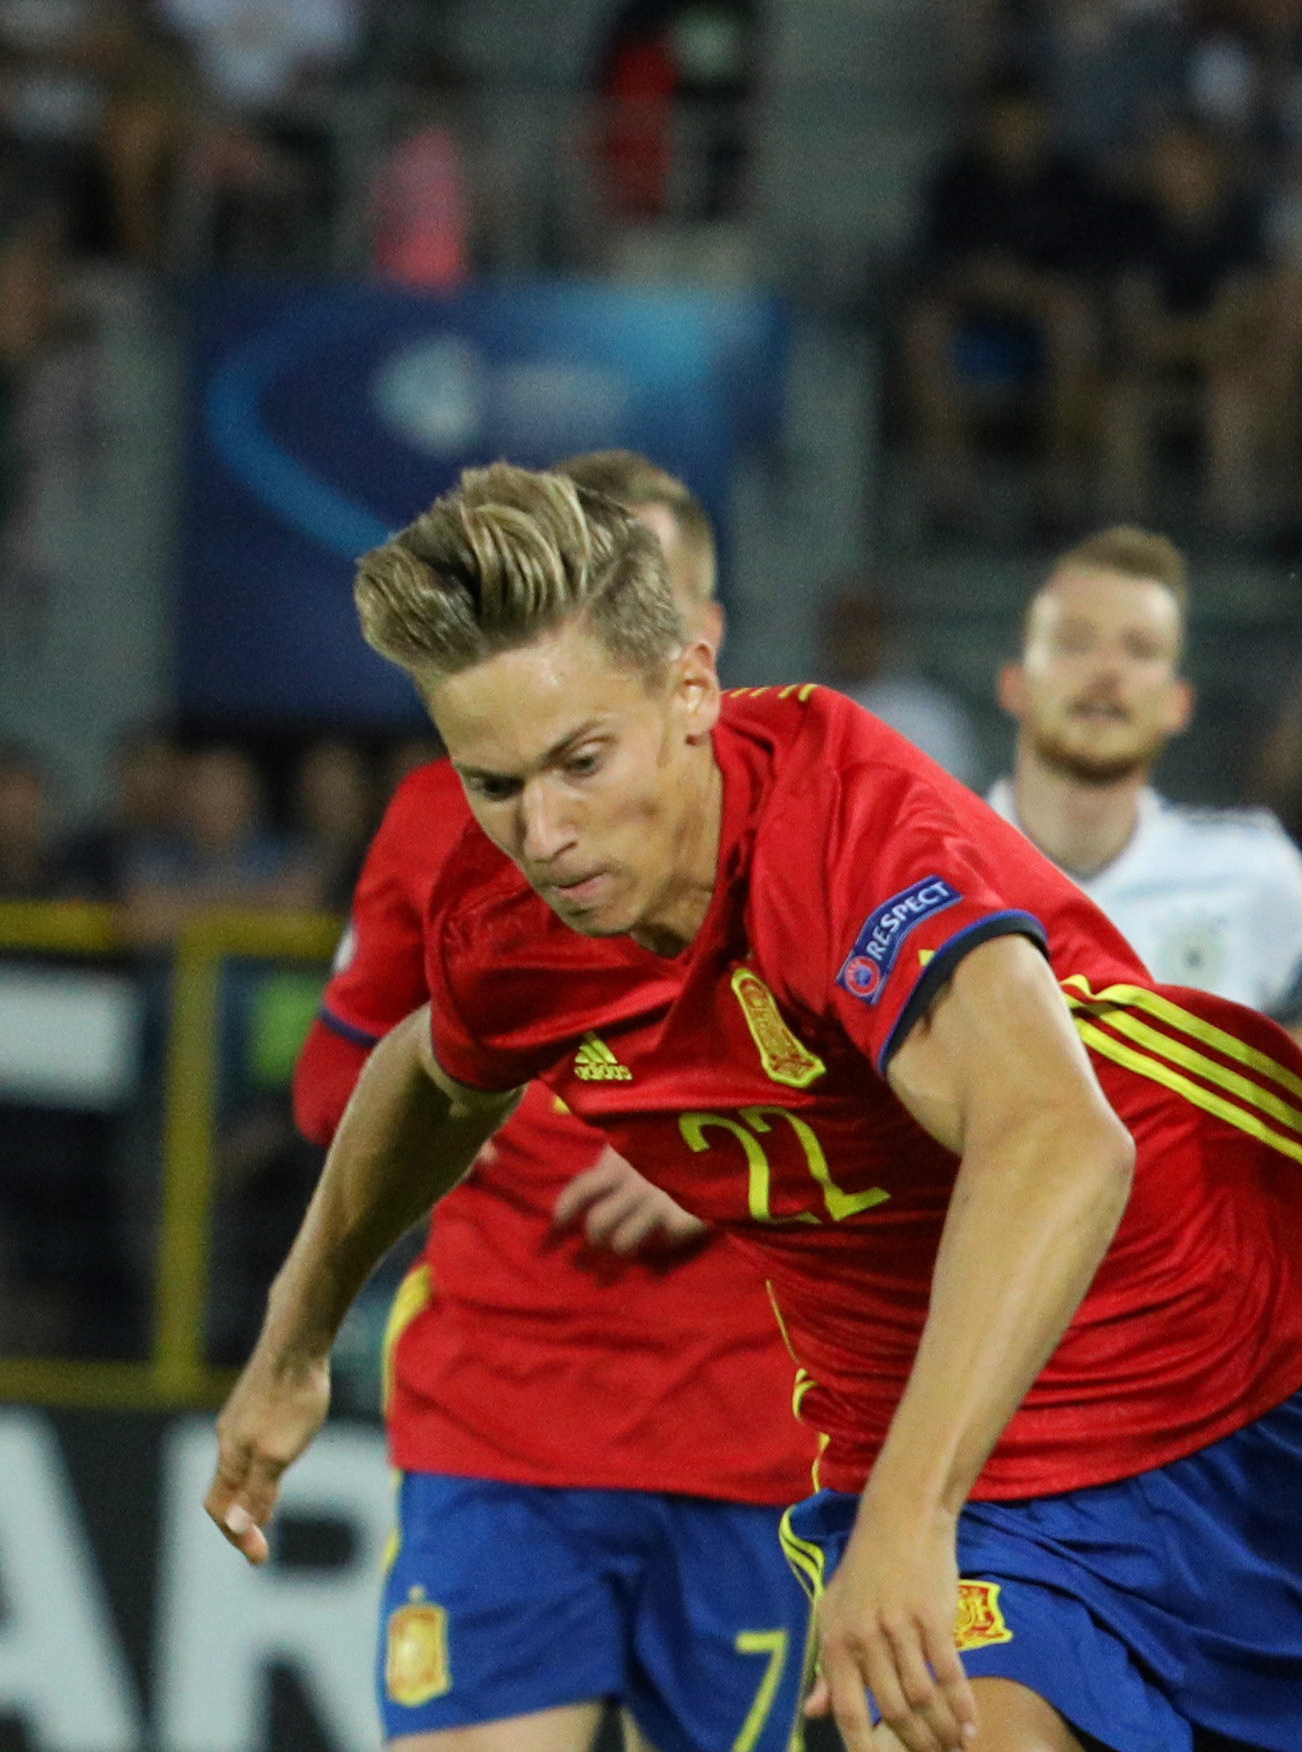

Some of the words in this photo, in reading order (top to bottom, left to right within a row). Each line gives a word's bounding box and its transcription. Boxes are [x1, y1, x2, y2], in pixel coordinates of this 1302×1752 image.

[865, 881, 950, 961] RESPECT
[574, 1064, 633, 1081] adidas
[678, 1105, 891, 1224] 22
